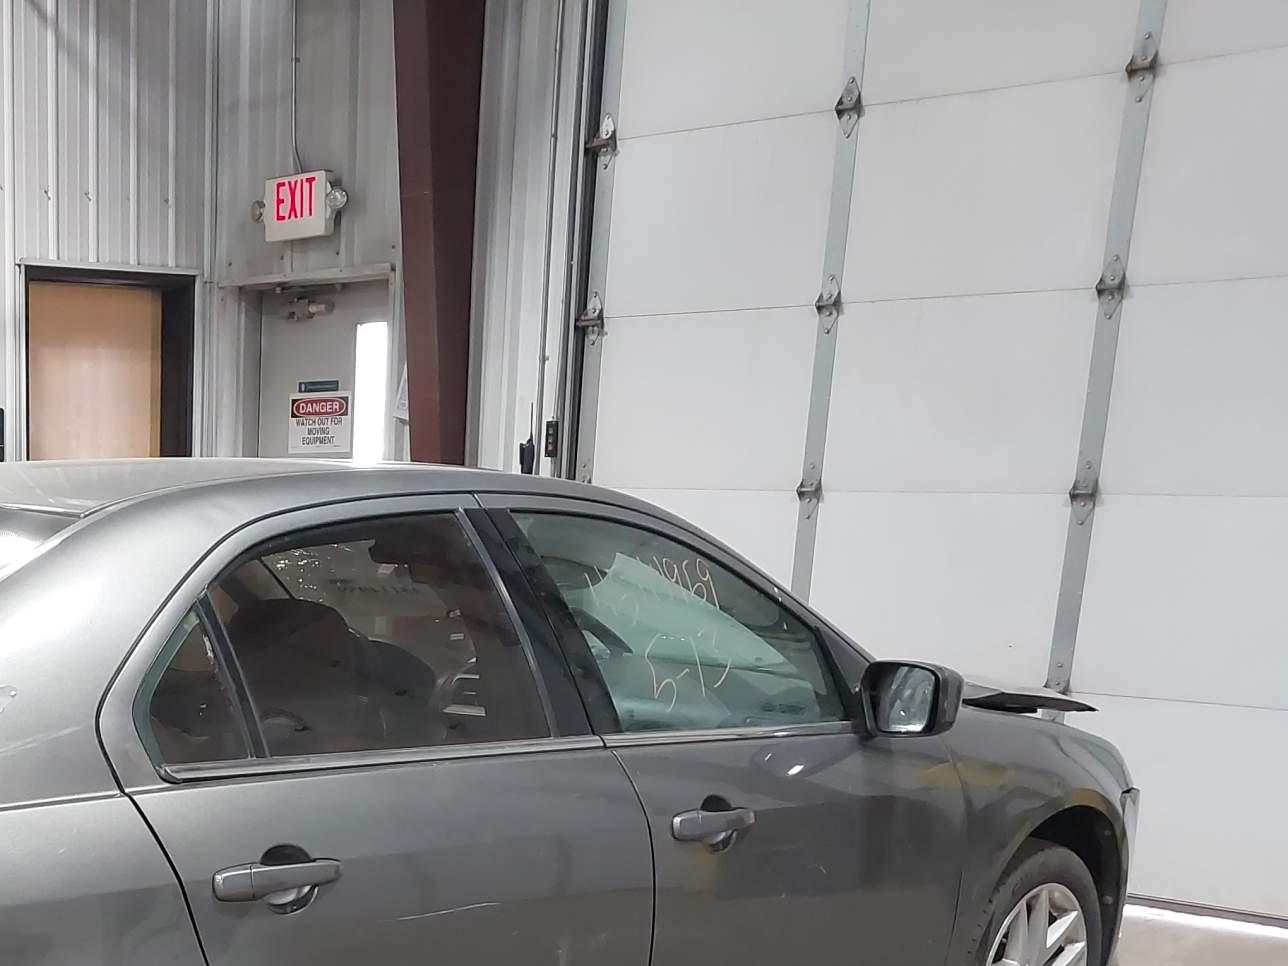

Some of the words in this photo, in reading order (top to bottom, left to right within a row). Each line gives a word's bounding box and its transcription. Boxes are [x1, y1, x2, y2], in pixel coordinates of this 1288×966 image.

[275, 175, 317, 222] EXIT
[299, 401, 340, 414] DANGER
[295, 418, 316, 427] WATCH
[317, 418, 330, 426] OUT
[330, 417, 343, 425] FOR
[307, 427, 330, 436] MOVING
[302, 436, 335, 445] EQUIPMENT
